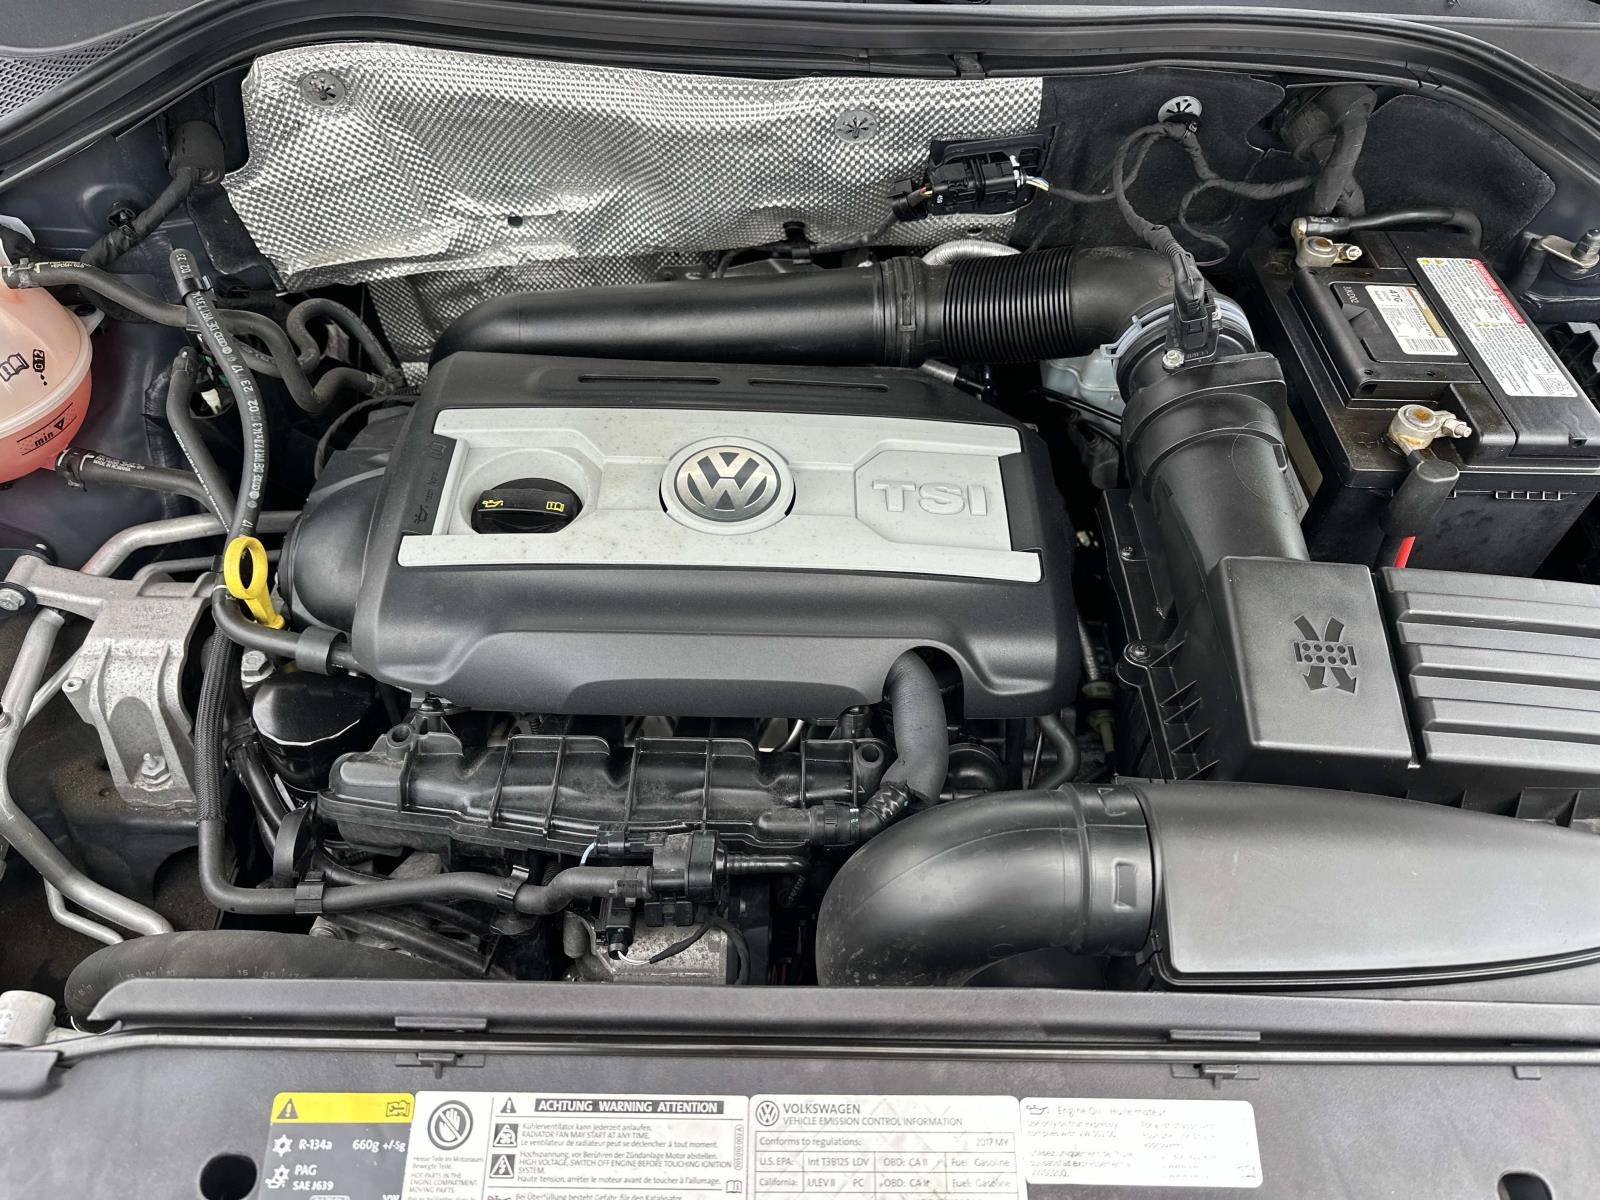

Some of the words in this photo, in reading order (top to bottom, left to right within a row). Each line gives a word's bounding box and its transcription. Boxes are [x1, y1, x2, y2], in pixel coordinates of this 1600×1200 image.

[34, 350, 45, 371] G12
[231, 364, 244, 374] 17
[241, 380, 254, 393] 23
[248, 399, 259, 412] 02
[34, 431, 54, 447] min
[872, 480, 988, 516] TSI
[538, 1100, 593, 1112] ACHTUNG
[598, 1101, 653, 1112] WARNING
[657, 1101, 718, 1113] ATTENTION
[783, 1103, 861, 1114] VOLKSWAGEN
[783, 1116, 817, 1126] VEHICLE
[819, 1116, 860, 1126] EMISSION
[862, 1117, 902, 1126] CONTROL
[903, 1117, 963, 1126] INFORMATION
[299, 1139, 333, 1150] R-134a
[352, 1139, 380, 1153] 660g
[760, 1136, 800, 1146] Conforms
[801, 1137, 811, 1146] to
[812, 1137, 862, 1148] regulations:
[976, 1138, 993, 1147] 2017
[760, 1157, 775, 1166] U.S.
[294, 1164, 318, 1176] PAG
[292, 1180, 310, 1191] SAE
[311, 1180, 334, 1191] J639
